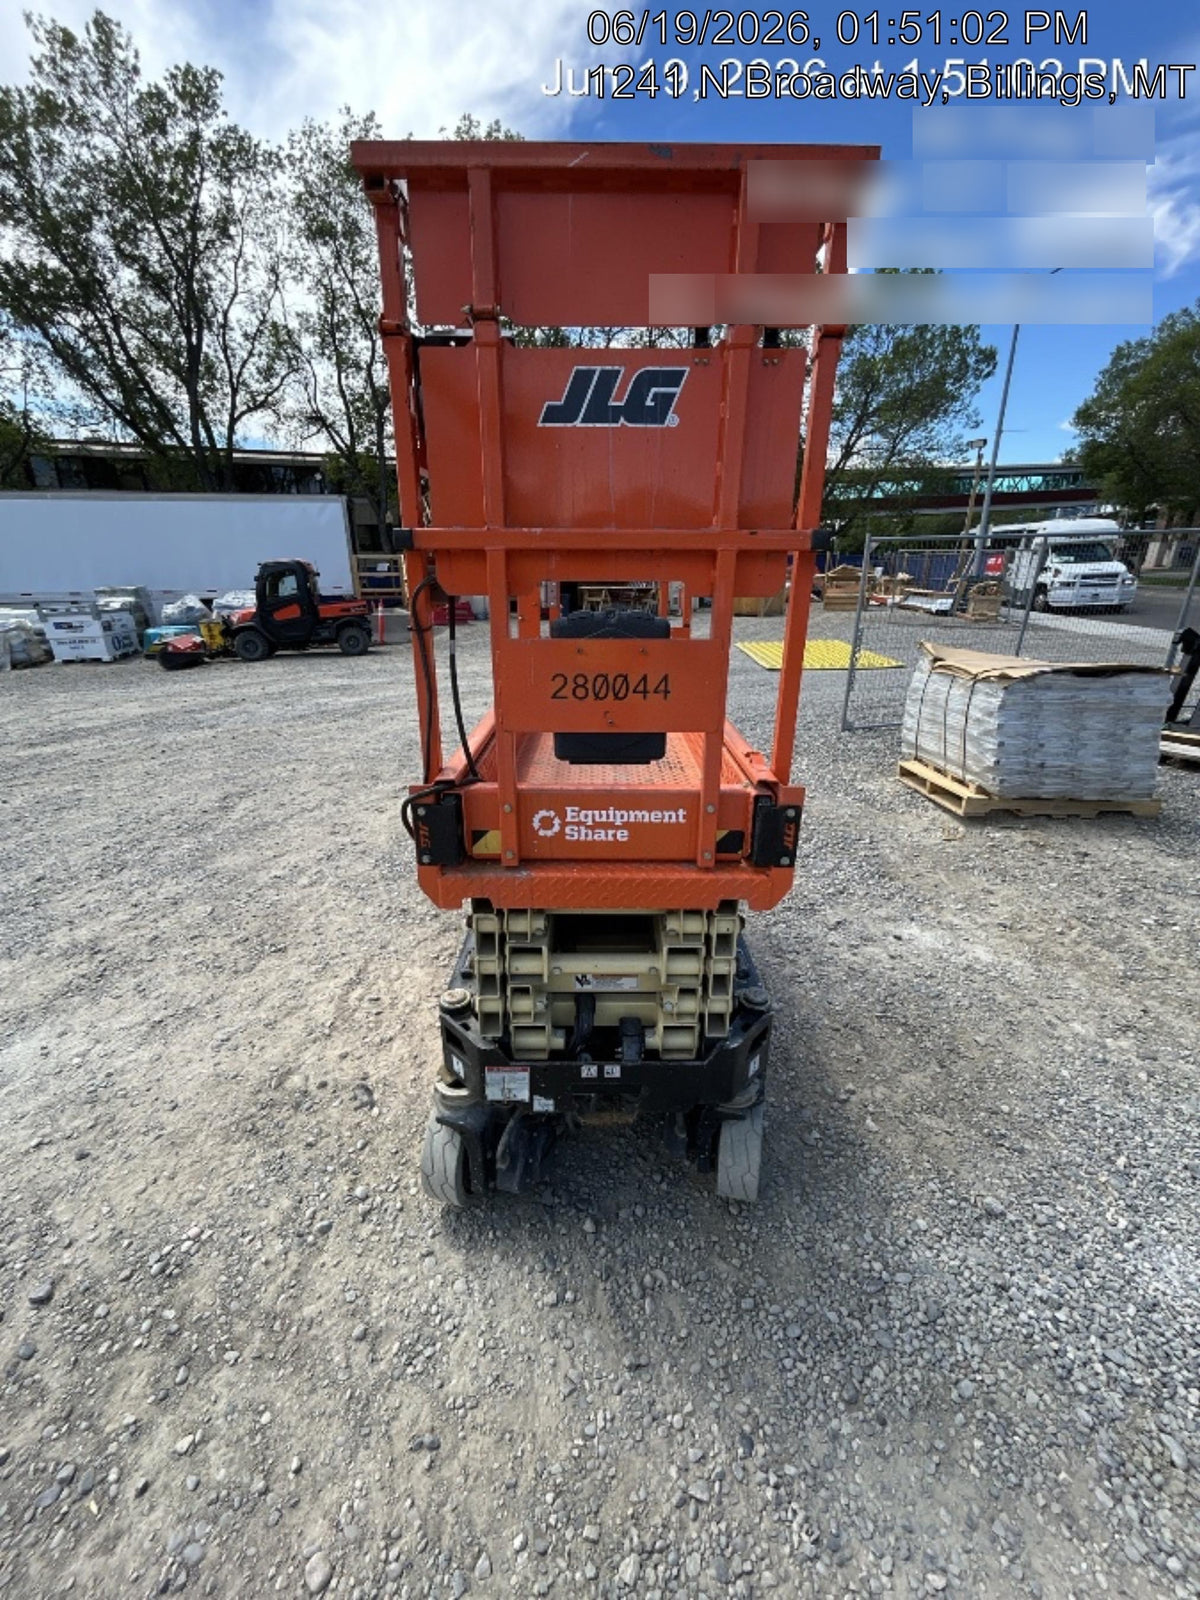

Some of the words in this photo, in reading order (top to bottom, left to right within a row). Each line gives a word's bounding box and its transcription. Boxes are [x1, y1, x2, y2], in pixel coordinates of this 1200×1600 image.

[537, 366, 690, 427] JLG
[551, 673, 671, 700] 280044
[565, 806, 687, 826] Equipment
[565, 825, 629, 841] Share
